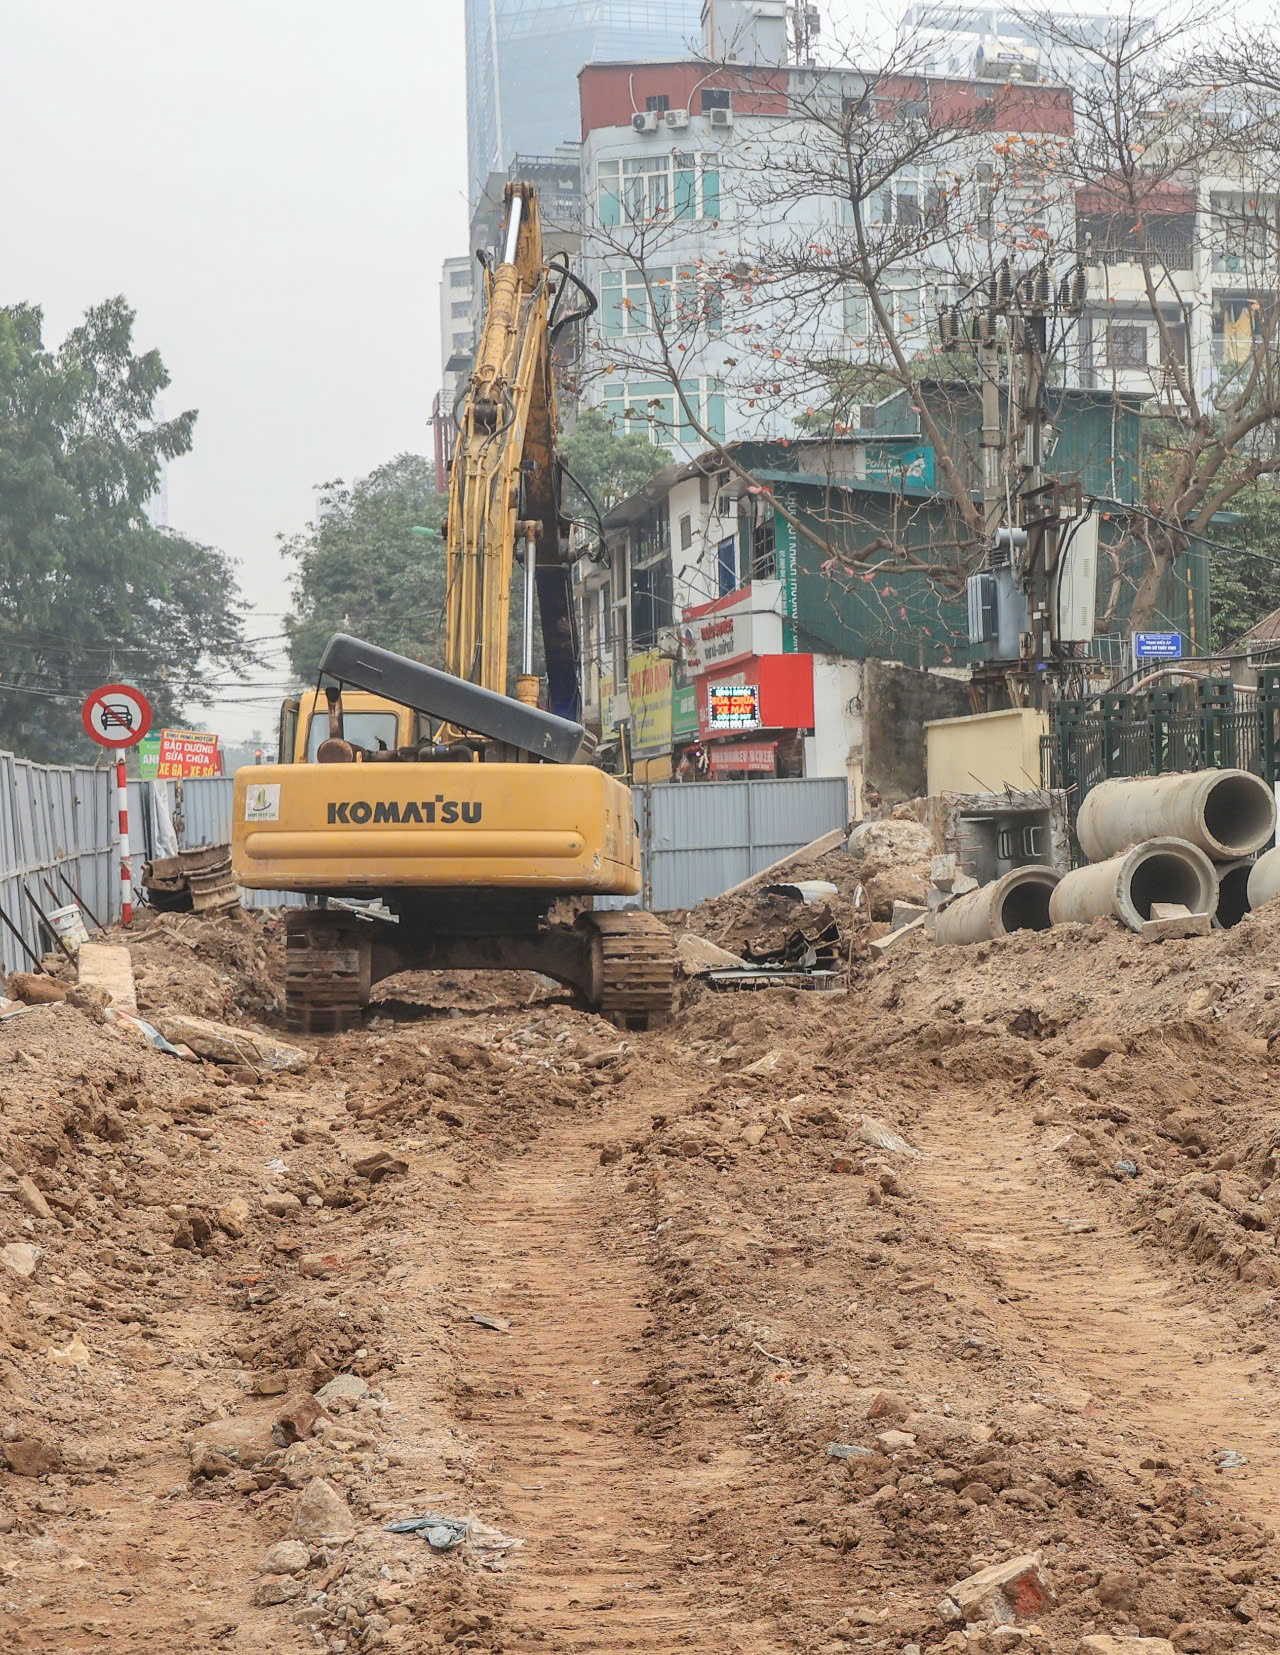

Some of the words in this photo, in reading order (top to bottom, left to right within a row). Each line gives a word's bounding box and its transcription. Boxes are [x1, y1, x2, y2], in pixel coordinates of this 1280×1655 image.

[716, 705, 729, 714] XE
[186, 753, 210, 764] CHỮA
[159, 762, 170, 775] XE
[172, 763, 183, 777] GA
[190, 765, 201, 777] XE
[202, 763, 215, 777] SỐ
[327, 794, 482, 824] KOMATSU
